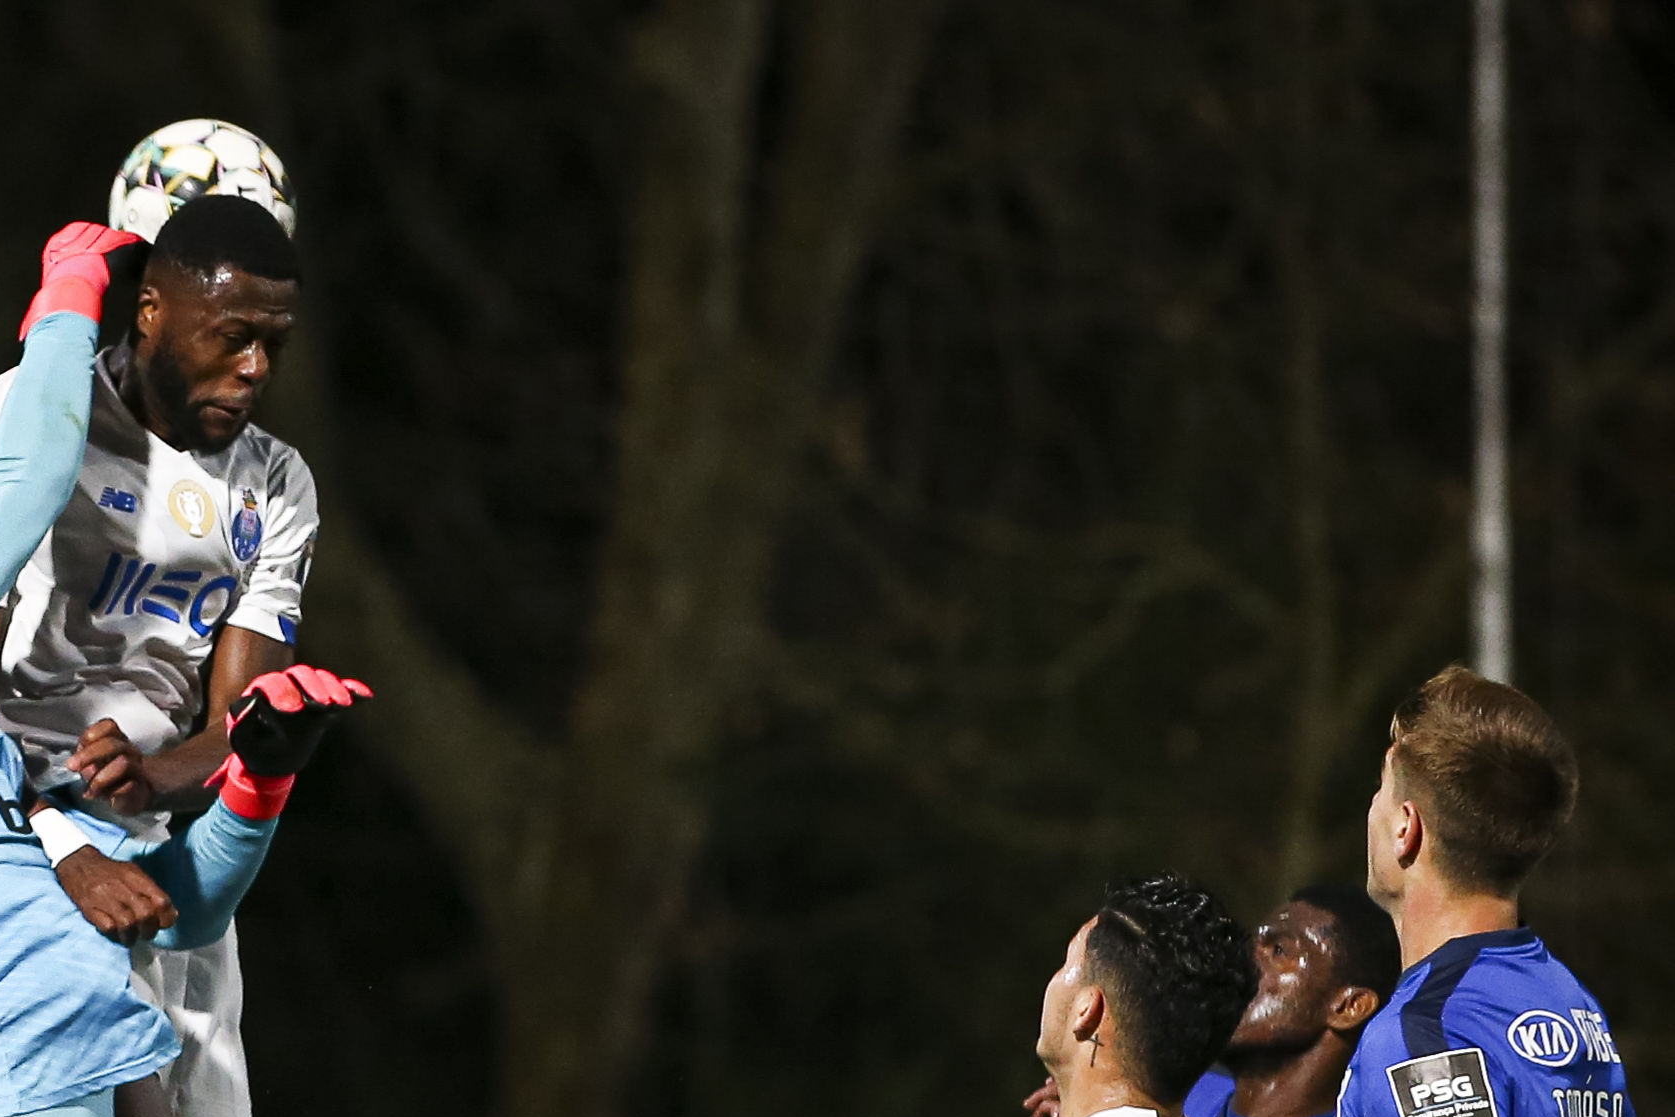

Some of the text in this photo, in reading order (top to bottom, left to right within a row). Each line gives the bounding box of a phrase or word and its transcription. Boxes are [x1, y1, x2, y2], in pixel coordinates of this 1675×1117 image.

[88, 551, 237, 638] MEO
[1516, 1020, 1571, 1058] KIA
[1409, 1075, 1475, 1108] PSG
